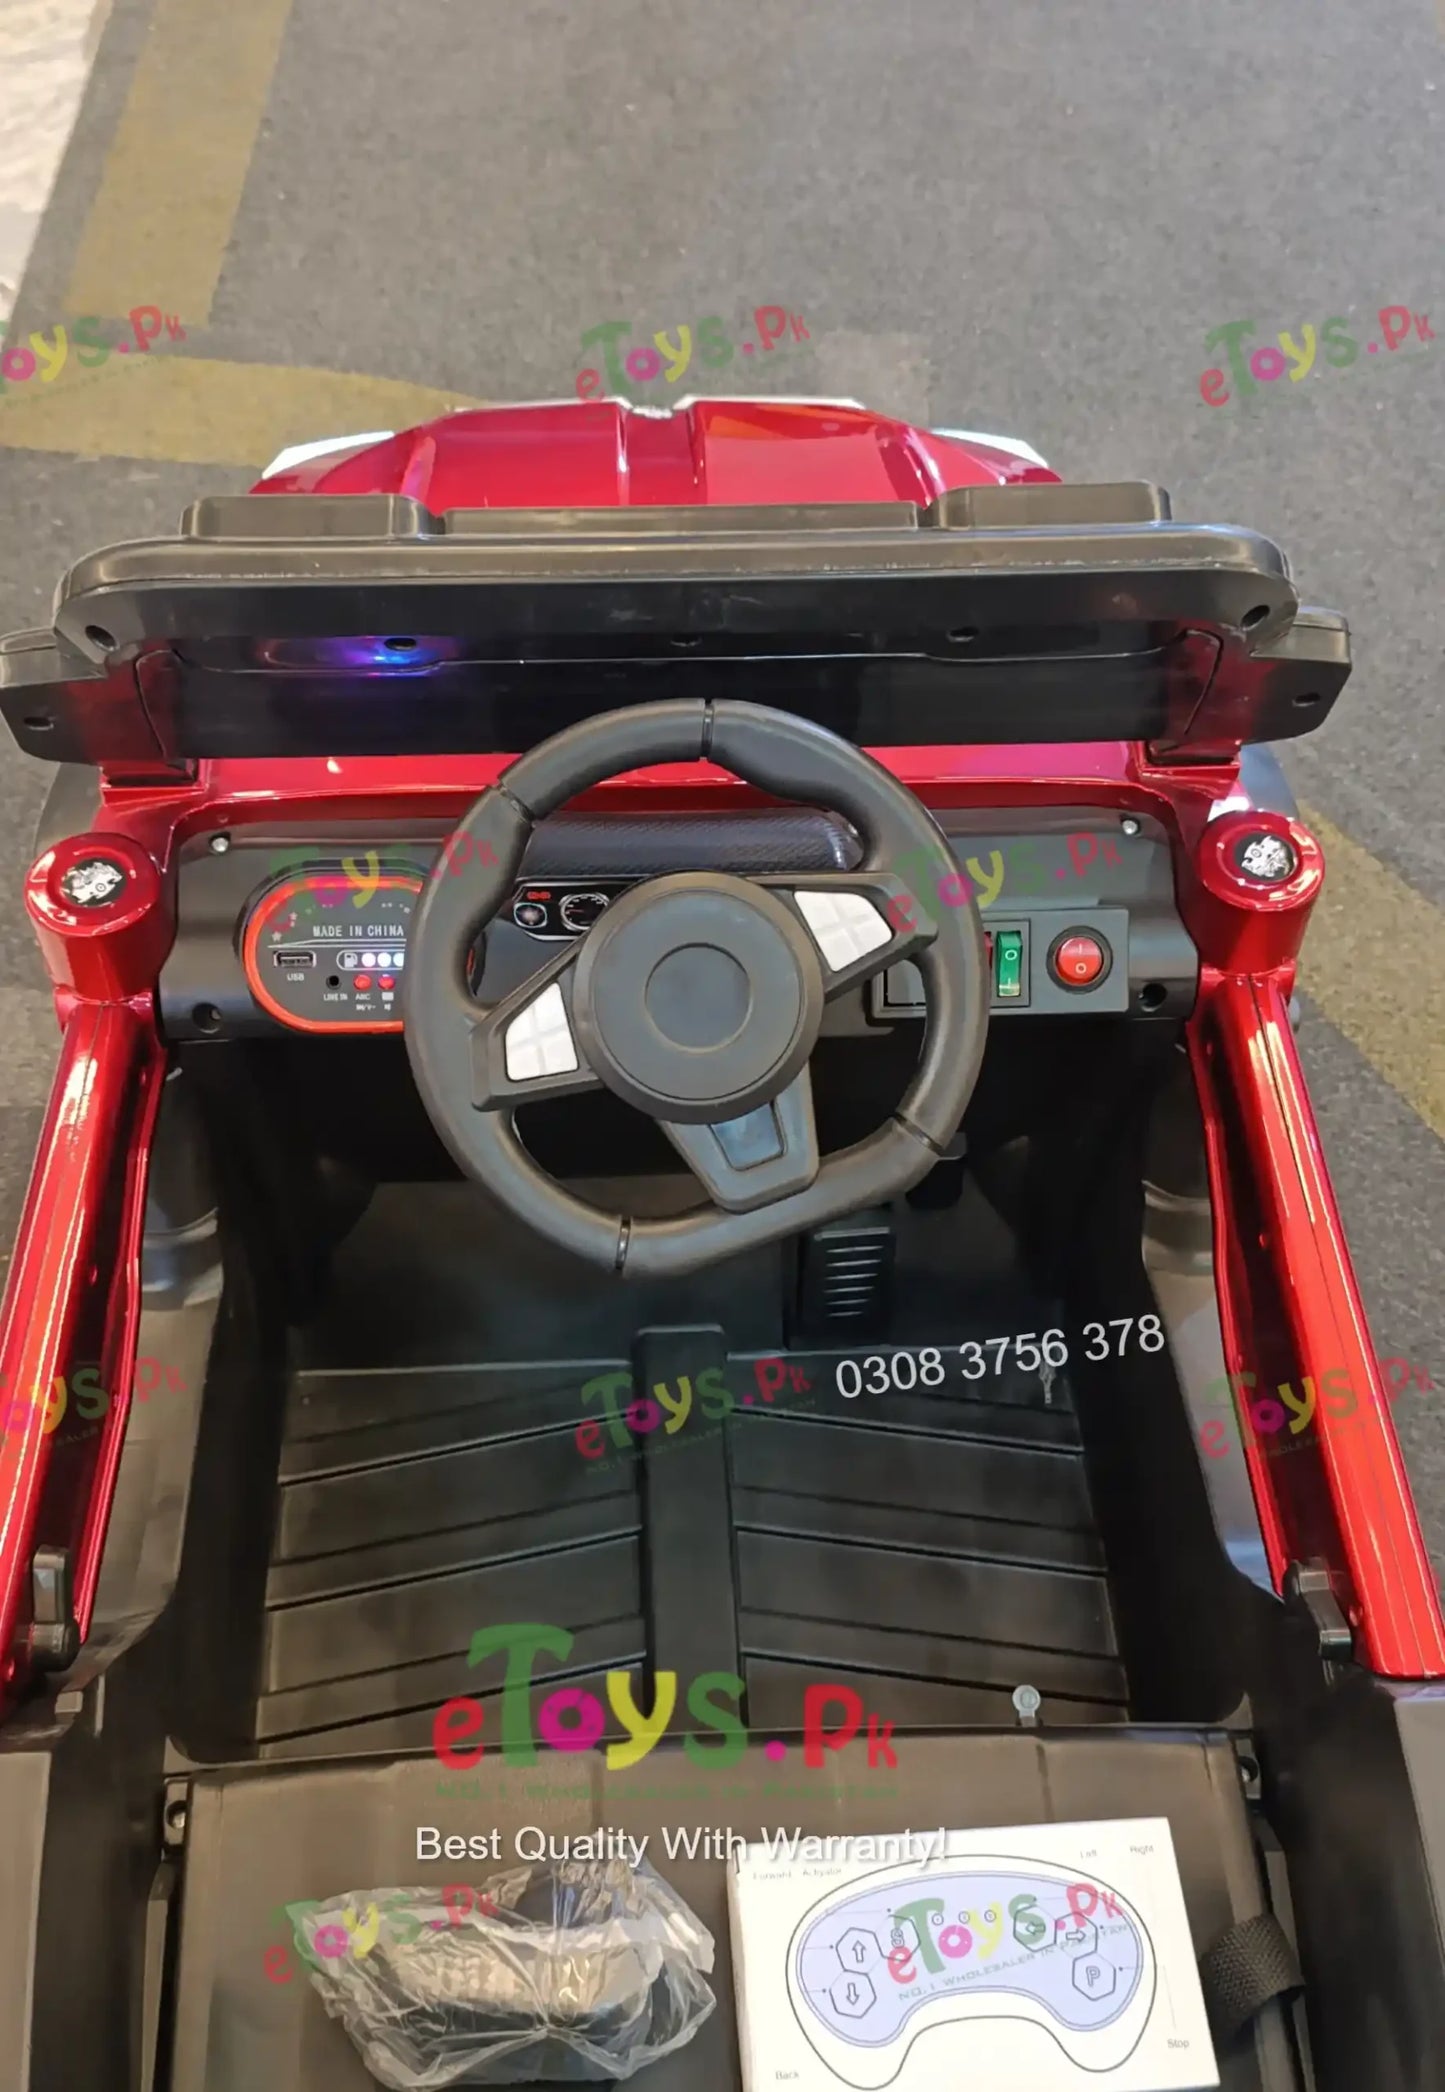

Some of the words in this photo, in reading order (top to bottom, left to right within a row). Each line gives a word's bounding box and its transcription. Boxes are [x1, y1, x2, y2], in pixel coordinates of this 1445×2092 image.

[312, 925, 342, 937] MADE
[349, 925, 363, 937] IN
[367, 925, 404, 937] CHINA
[286, 973, 305, 981] USB
[1085, 1965, 1101, 1988] P
[1167, 2038, 1190, 2051] Stop
